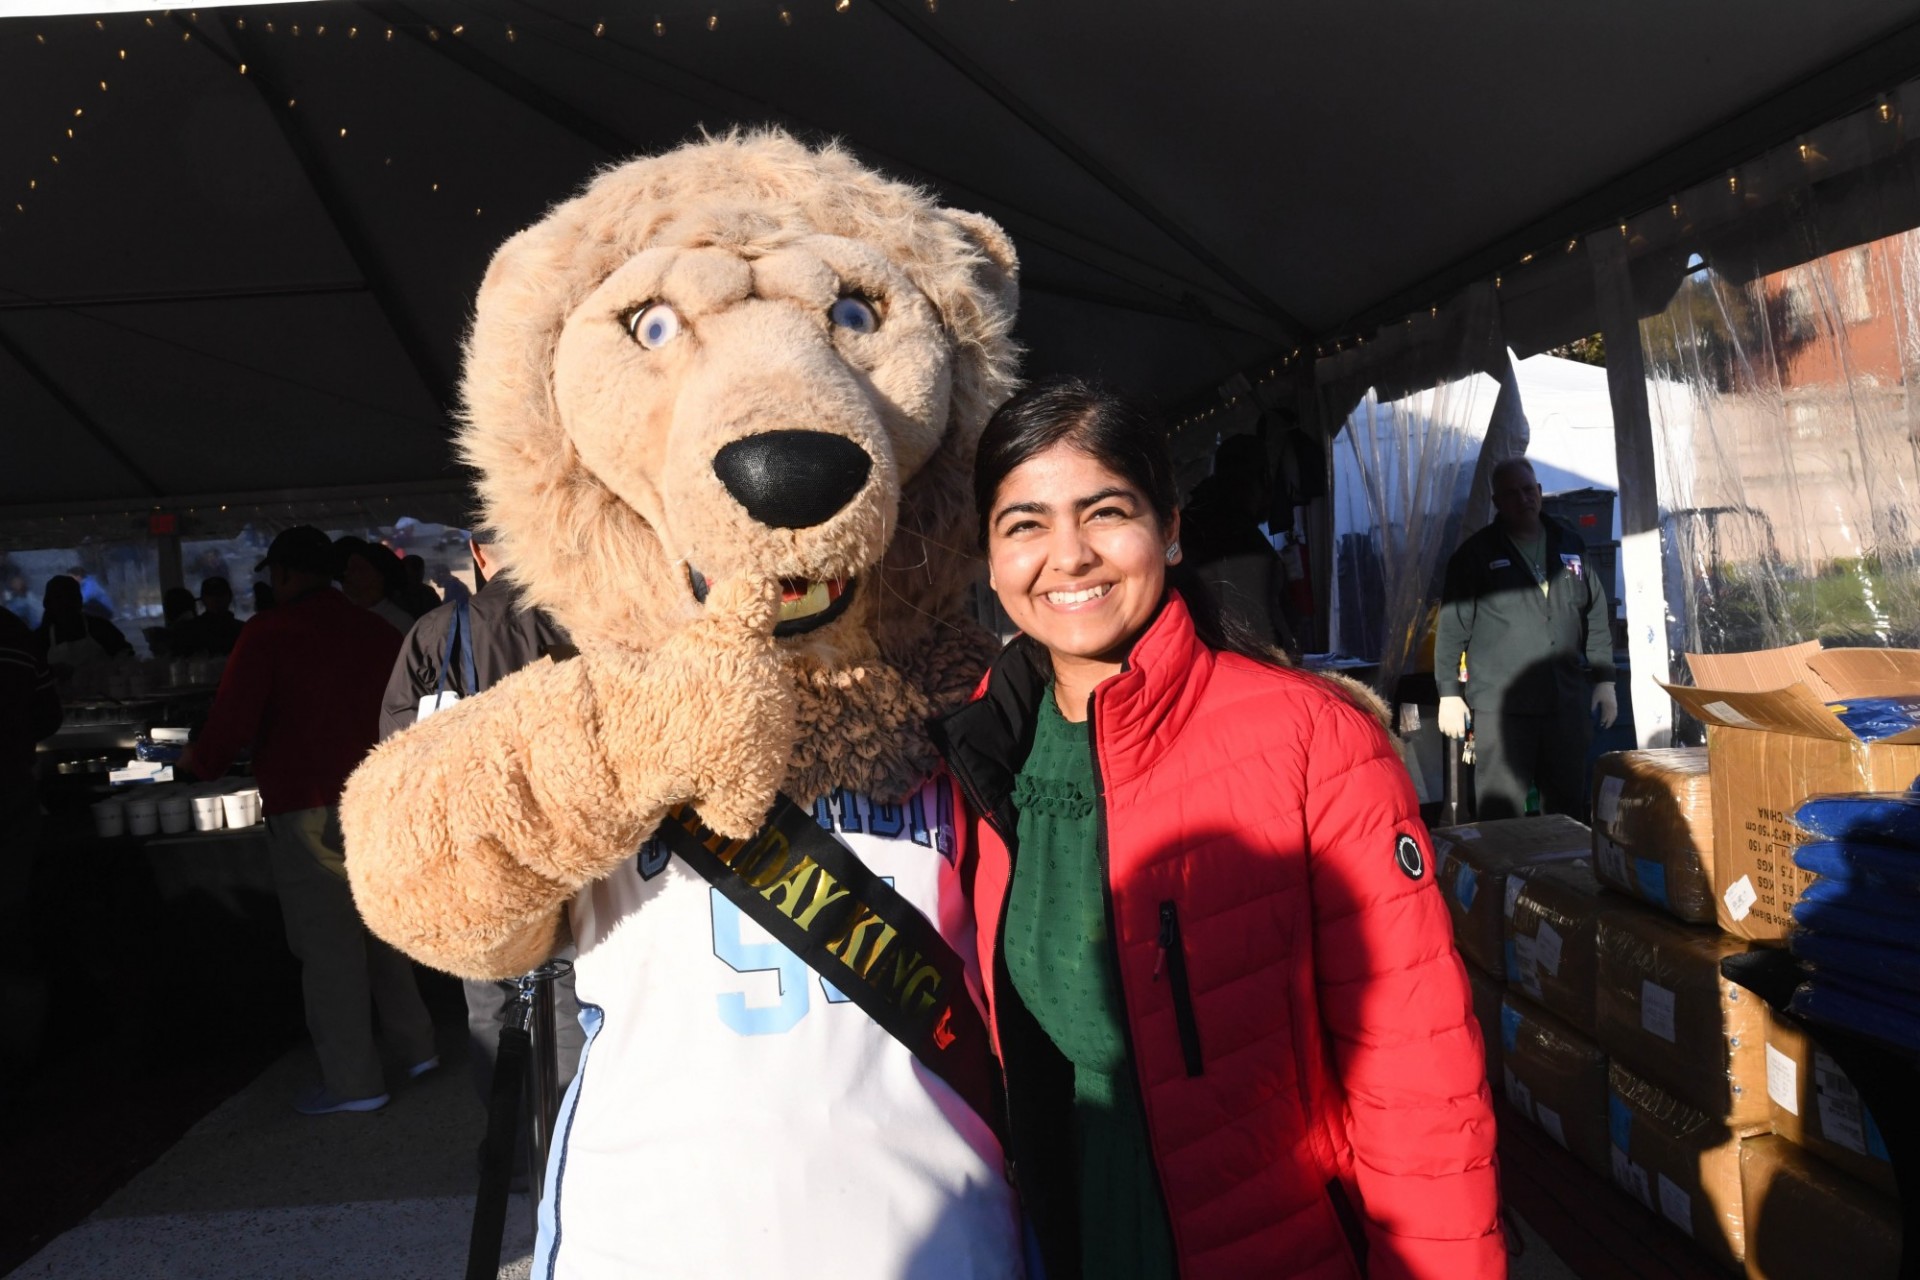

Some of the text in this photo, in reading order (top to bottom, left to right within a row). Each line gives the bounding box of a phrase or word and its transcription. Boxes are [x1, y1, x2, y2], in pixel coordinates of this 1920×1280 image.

[1757, 808, 1783, 823] CHINA
[1745, 822, 1757, 832] cm
[1748, 839, 1761, 852] 150
[1764, 843, 1773, 854] of
[1757, 859, 1773, 874] KGS
[1781, 865, 1793, 879] 7.5
[1757, 876, 1794, 897] 6.5 KGS
[1761, 894, 1775, 906] pcs
[826, 900, 942, 1015] KING
